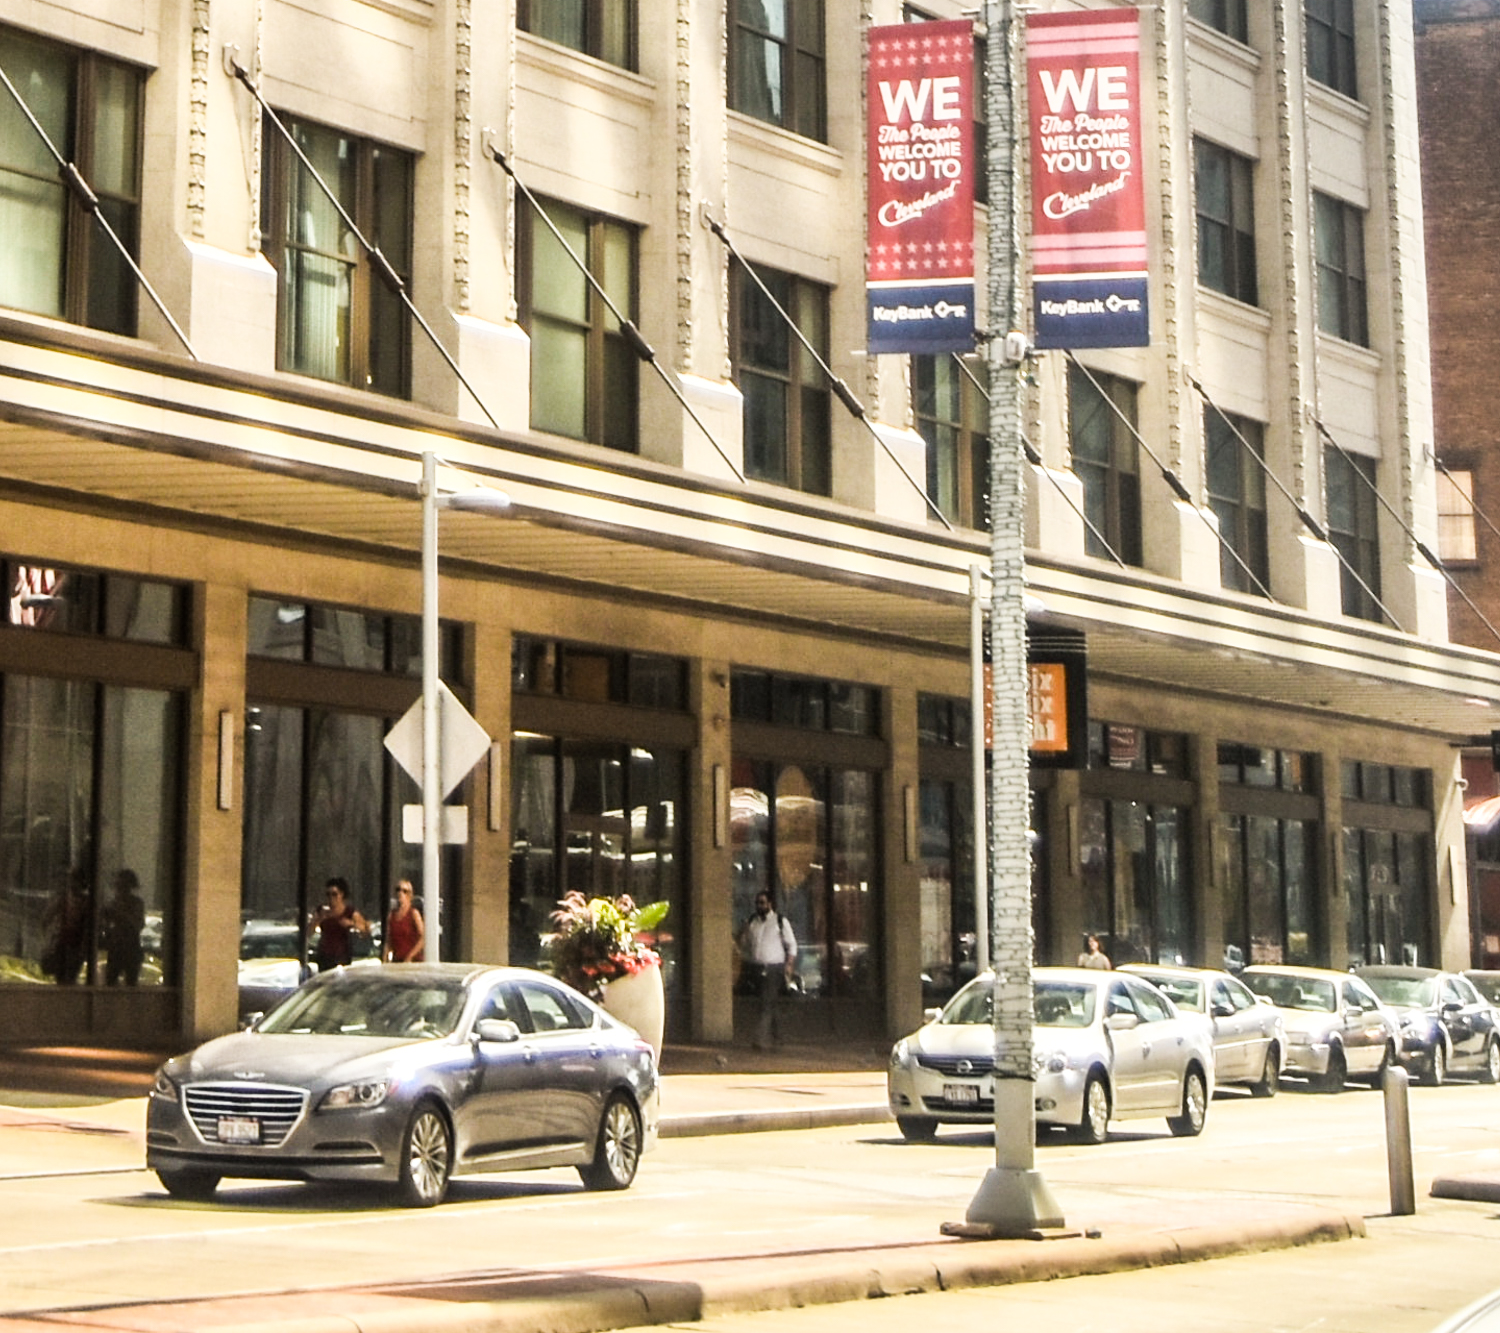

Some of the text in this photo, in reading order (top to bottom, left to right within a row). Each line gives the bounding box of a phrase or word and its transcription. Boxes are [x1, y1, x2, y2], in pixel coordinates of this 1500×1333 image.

[877, 75, 962, 124] WE
[1038, 65, 1130, 114] WE
[878, 122, 962, 144] The People
[1040, 112, 1130, 134] The People
[878, 140, 962, 161] WELCOME
[1040, 131, 1131, 151] WELCOME
[878, 158, 962, 183] YOU TO
[1041, 149, 1132, 174] YOU TO
[877, 180, 958, 228] Cleveland
[1042, 172, 1128, 220] Cleveland
[873, 304, 934, 322] KeyBank
[1040, 298, 1105, 316] KeyBank
